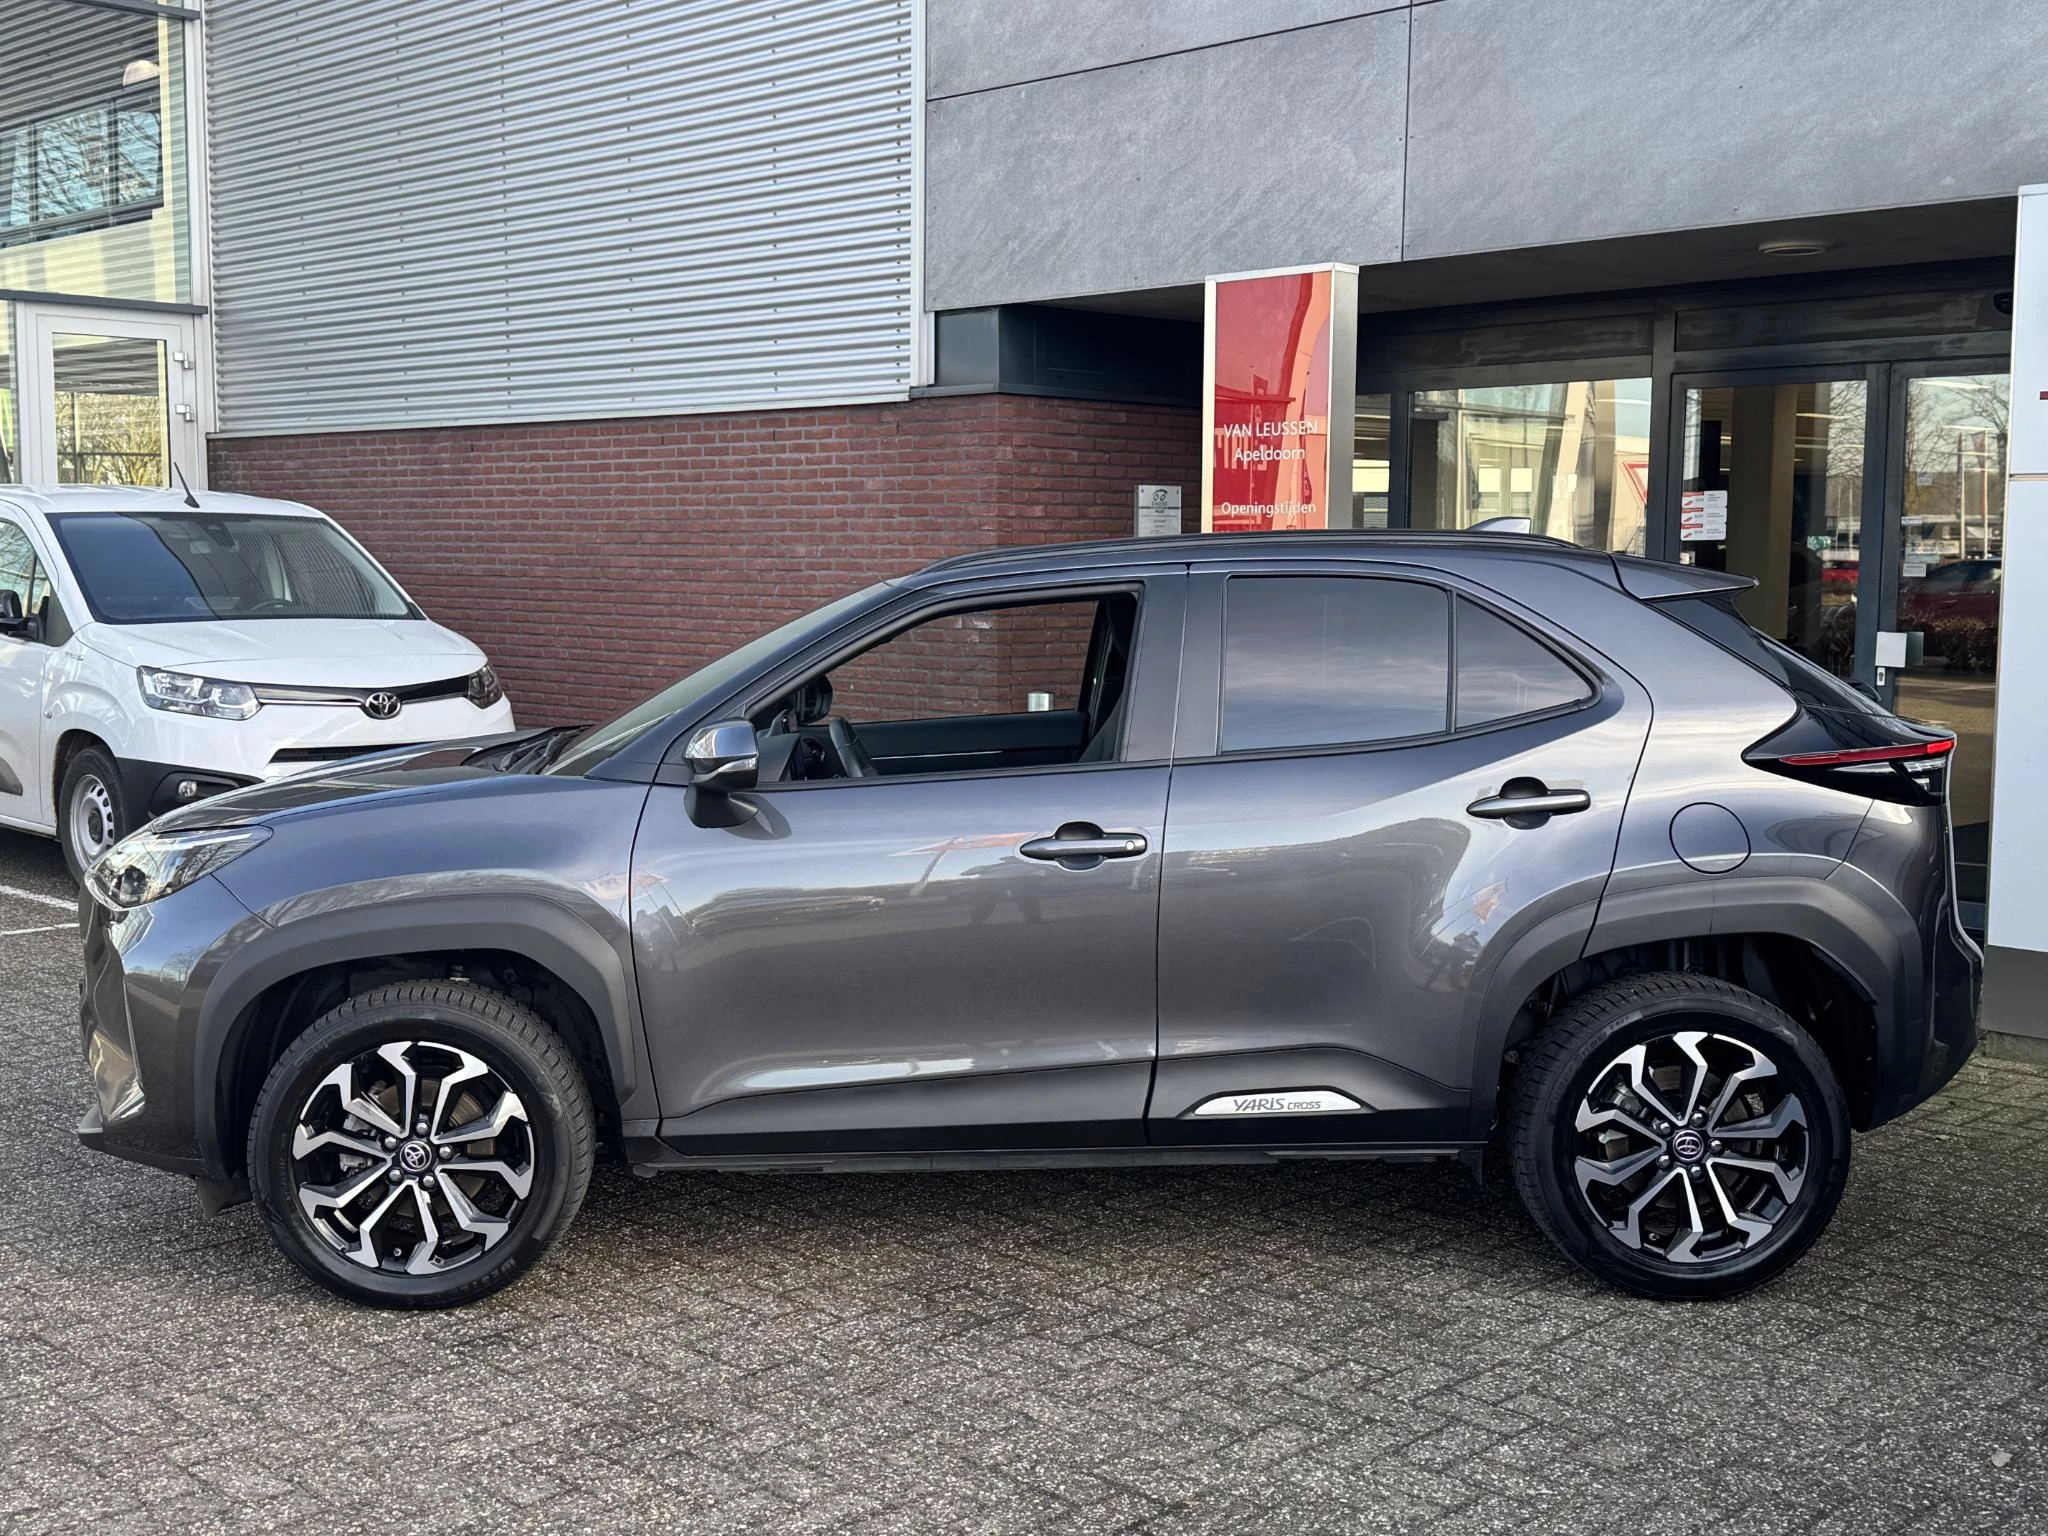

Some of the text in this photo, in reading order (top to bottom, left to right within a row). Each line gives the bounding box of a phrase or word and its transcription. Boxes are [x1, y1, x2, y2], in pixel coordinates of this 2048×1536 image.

[1223, 421, 1318, 438] VAN LEUSSEN
[1234, 445, 1305, 465] Apeldoorn
[1221, 501, 1317, 518] Openingstijden
[1287, 1101, 1321, 1110] CROSS
